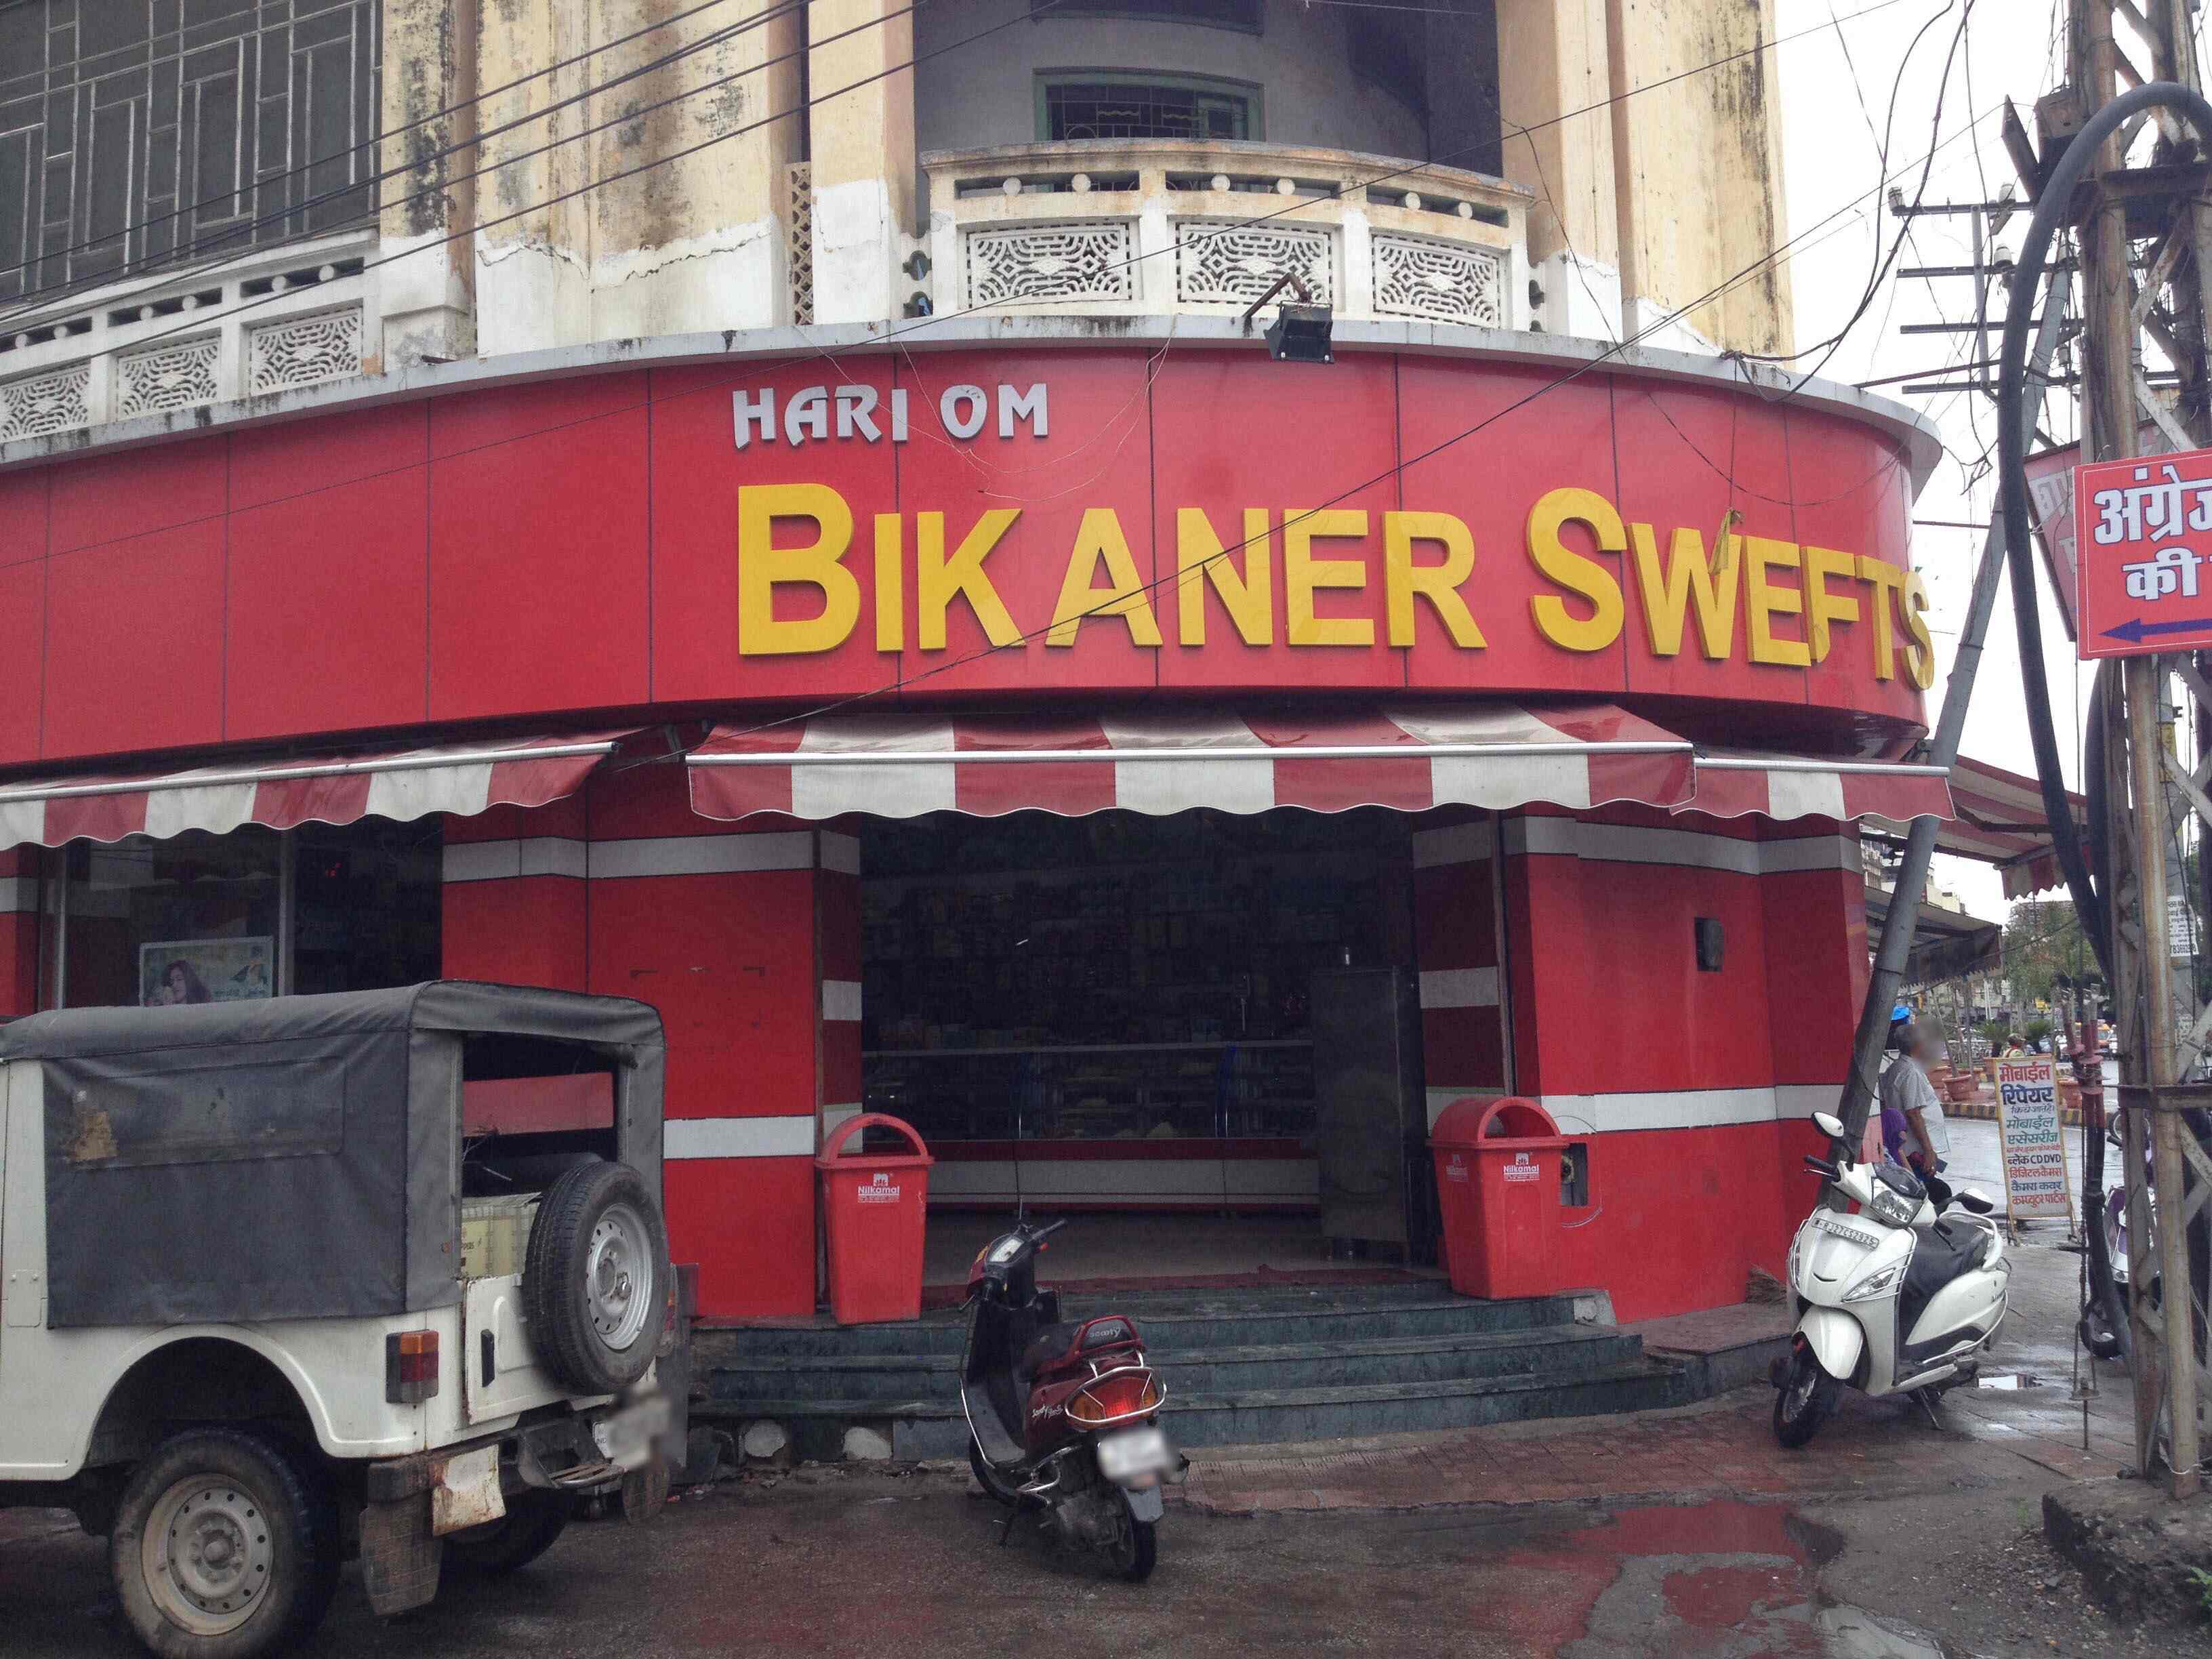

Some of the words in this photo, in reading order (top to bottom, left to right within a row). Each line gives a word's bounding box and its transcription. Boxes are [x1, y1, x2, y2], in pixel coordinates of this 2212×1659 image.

[733, 385, 908, 449] HARI
[941, 382, 1048, 439] OM
[737, 483, 1486, 657] BIKANER
[2121, 546, 2204, 601] की
[1999, 1061, 2050, 1083] मोबाईल
[2001, 1084, 2053, 1105] रिपेयर
[2006, 1115, 2055, 1130] मोबाईल
[1503, 1164, 1540, 1173] Nilkamal
[857, 1185, 900, 1193] Nilkamal
